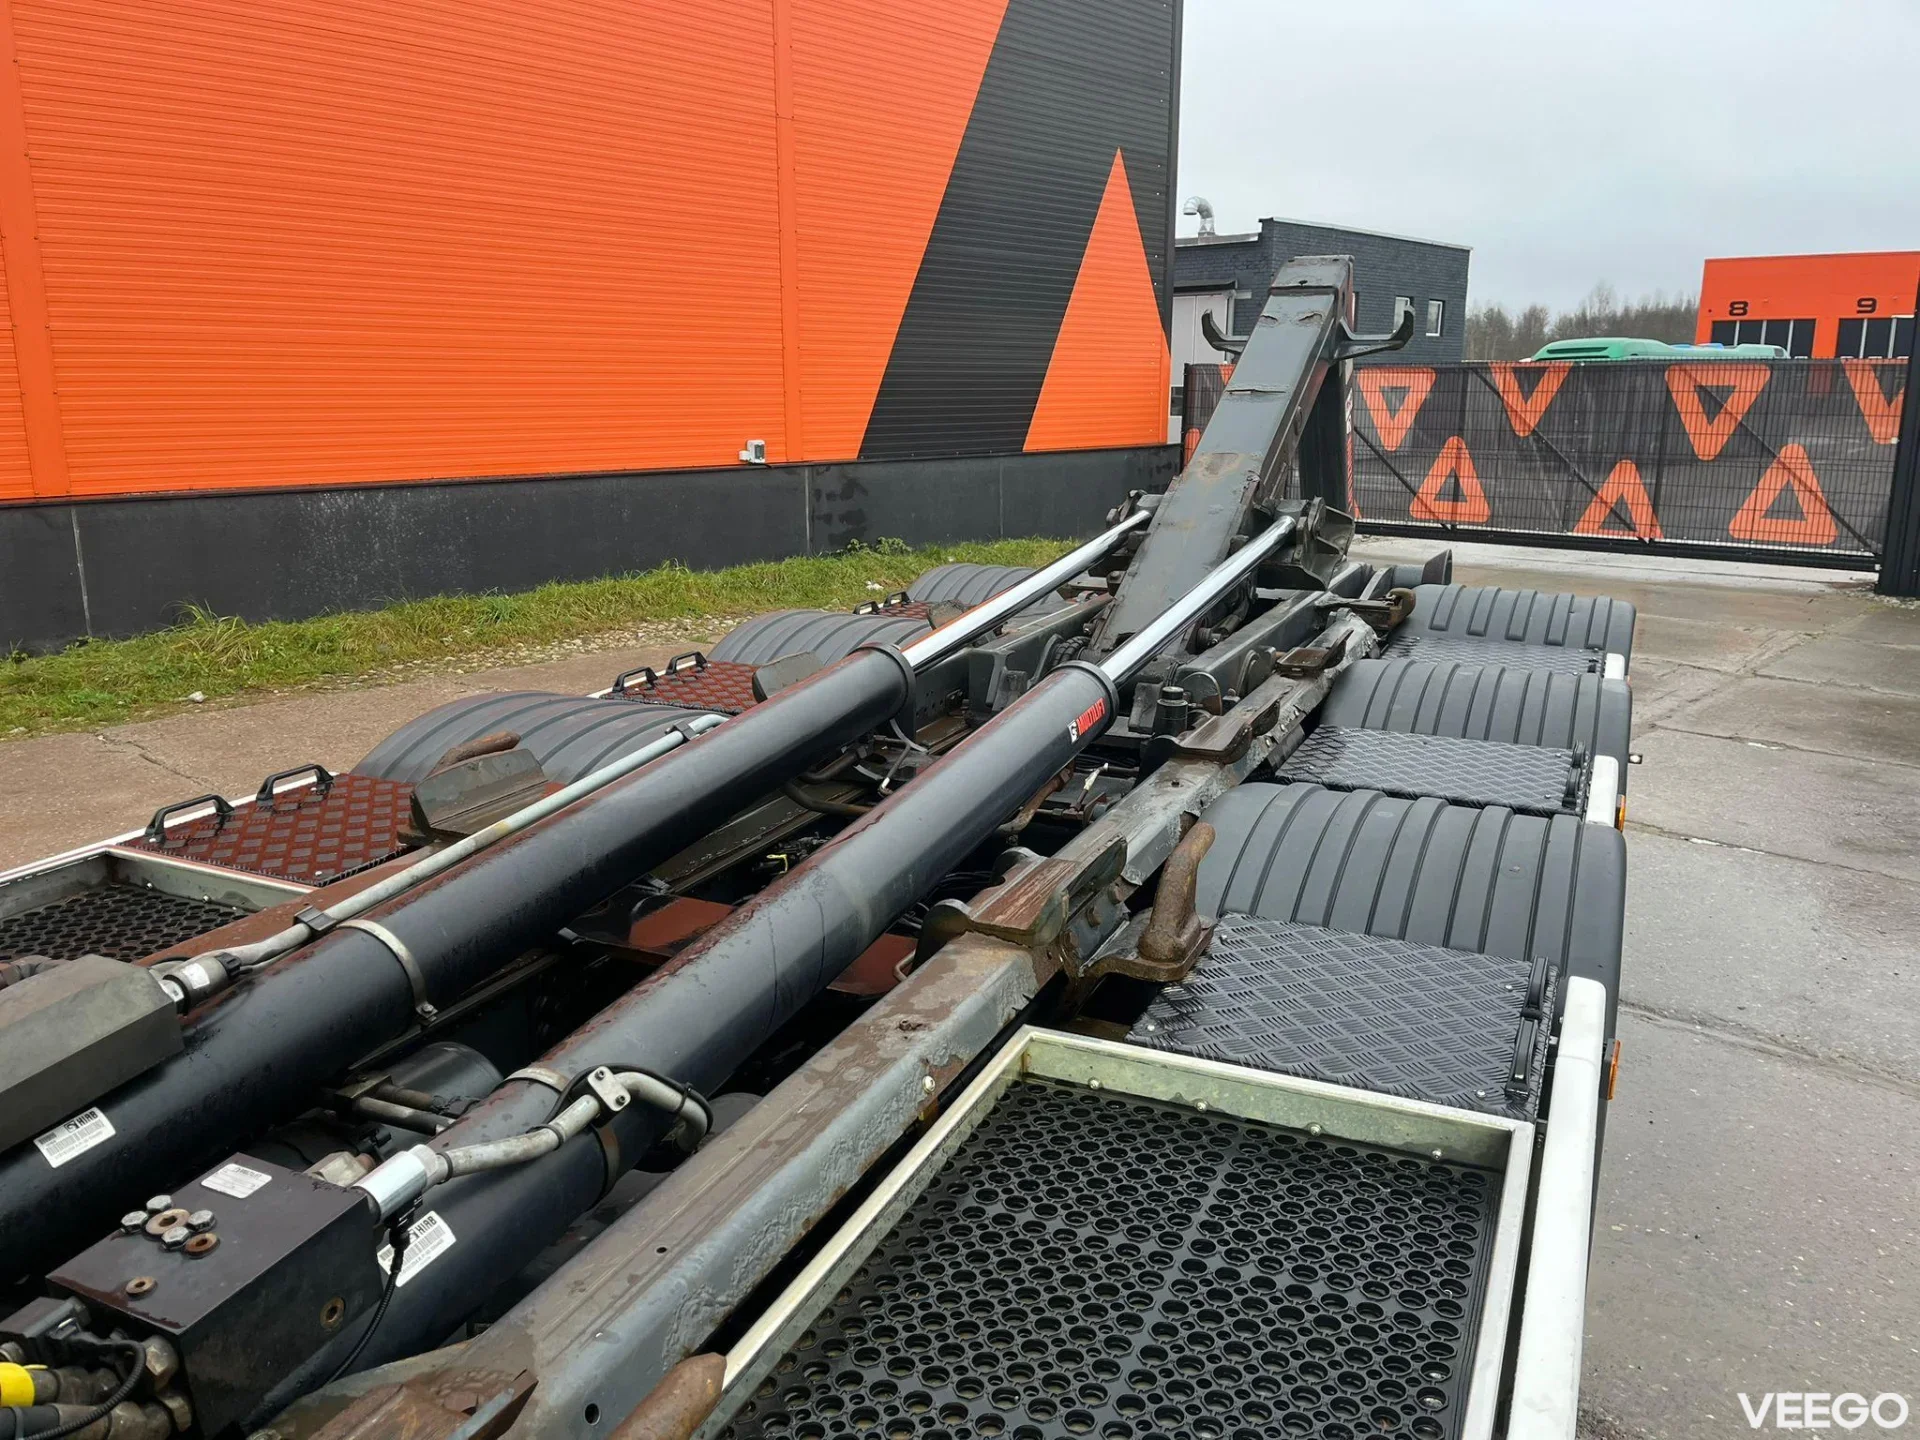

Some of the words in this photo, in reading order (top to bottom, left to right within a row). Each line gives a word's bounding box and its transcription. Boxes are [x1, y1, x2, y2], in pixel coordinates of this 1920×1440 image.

[1729, 301, 1748, 316] 8
[1856, 297, 1877, 314] 9
[1076, 697, 1106, 736] MULTILIFT
[77, 1110, 99, 1126] HIAB
[415, 1215, 437, 1235] HIAB
